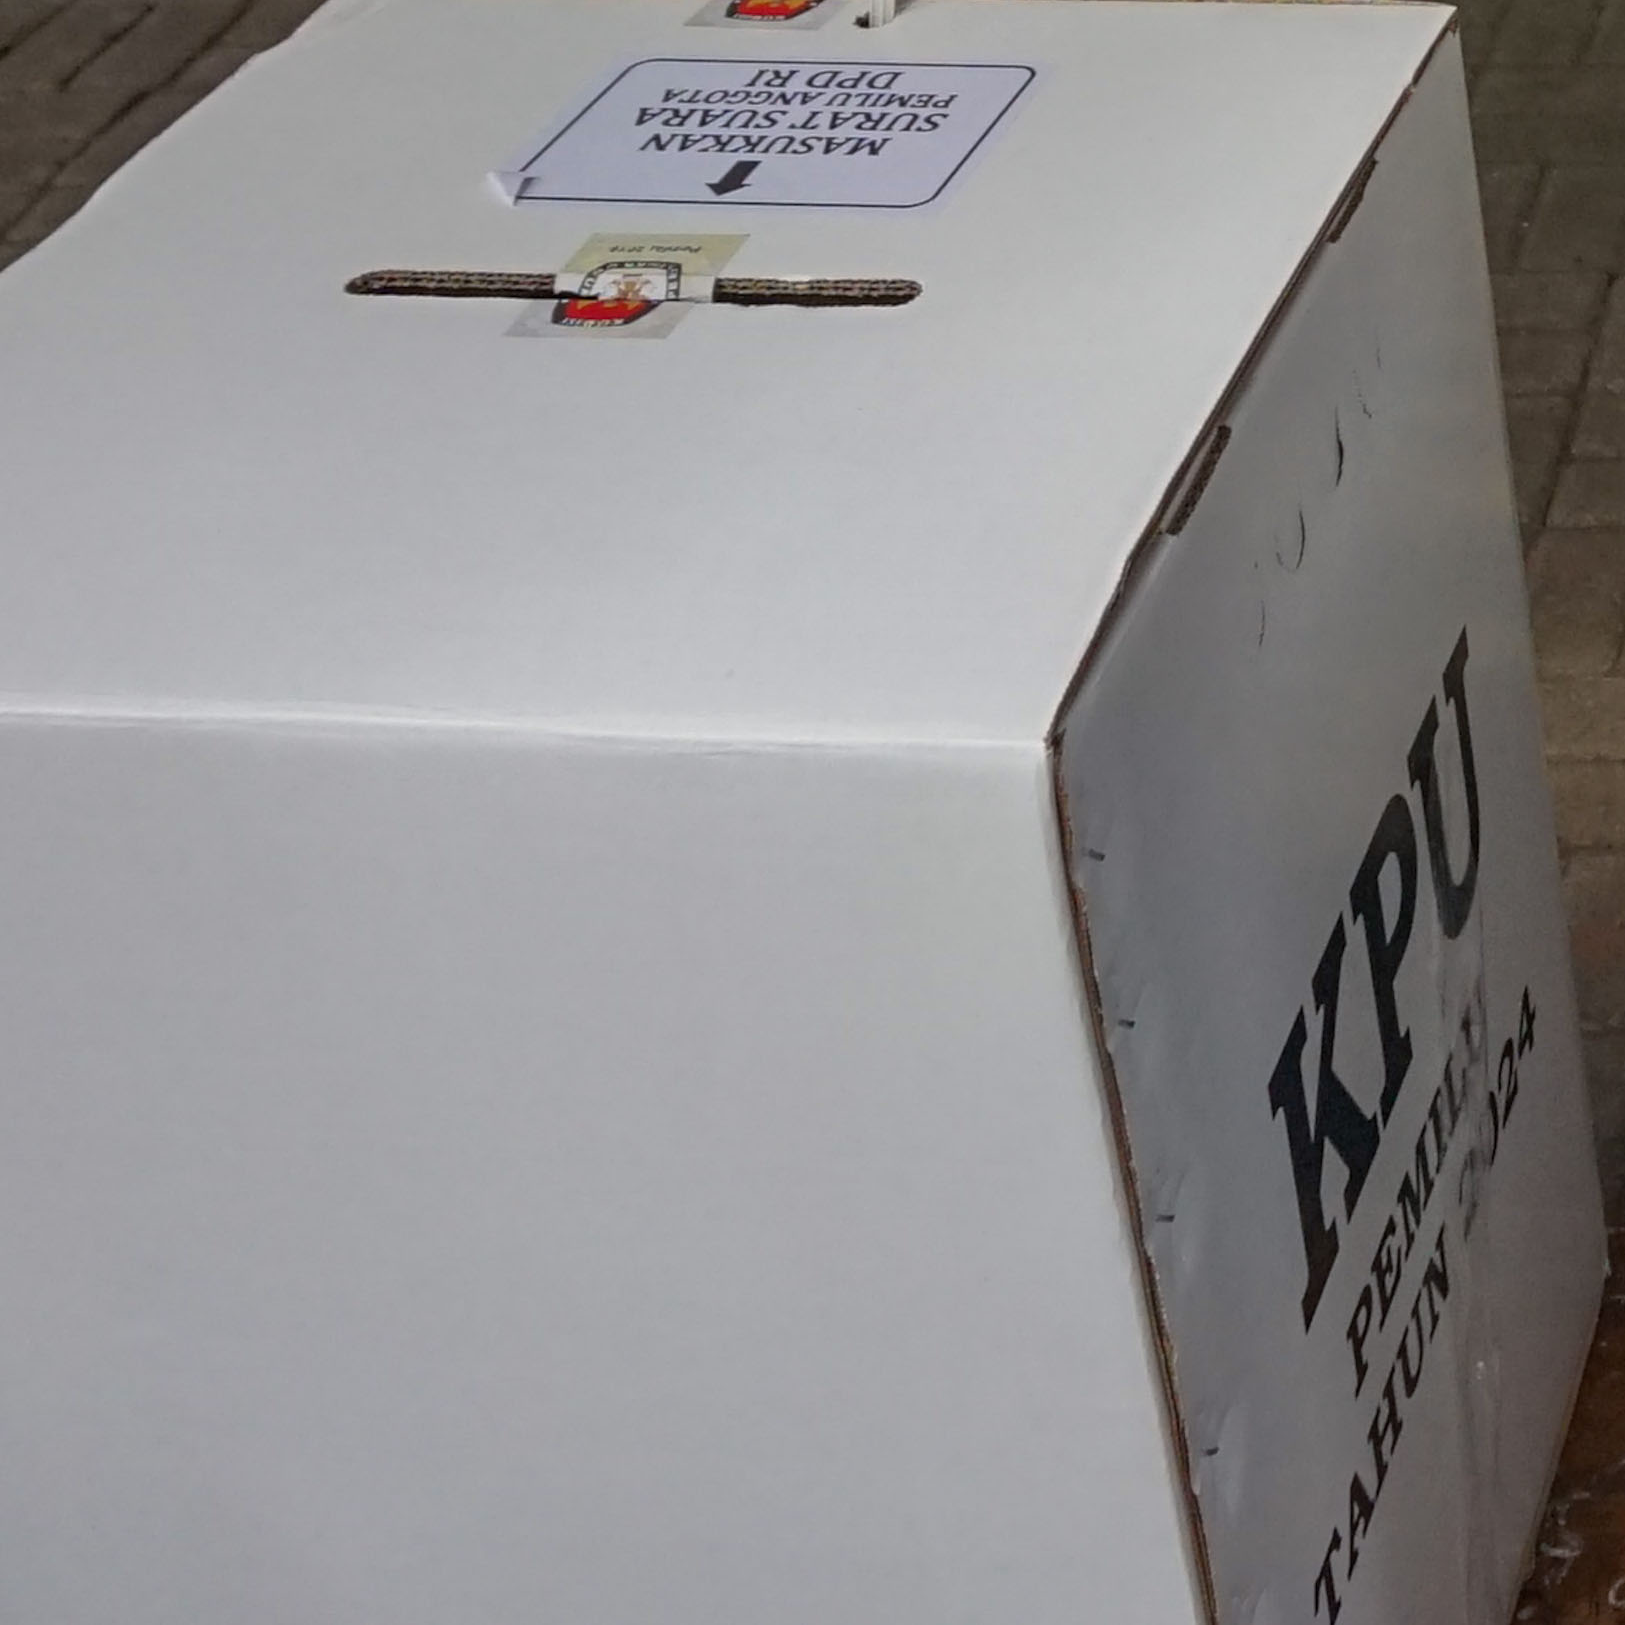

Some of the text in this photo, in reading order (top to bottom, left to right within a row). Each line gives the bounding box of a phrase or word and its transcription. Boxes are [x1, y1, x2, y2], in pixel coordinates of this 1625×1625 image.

[744, 68, 905, 90] DPD RI
[660, 88, 958, 109] PEMILU ANGGOTA
[634, 107, 950, 132] SURAT SUARA
[638, 133, 893, 156] MASUKKAN
[1267, 623, 1481, 1335] KPU
[1314, 1223, 1451, 1625] TAHUN
